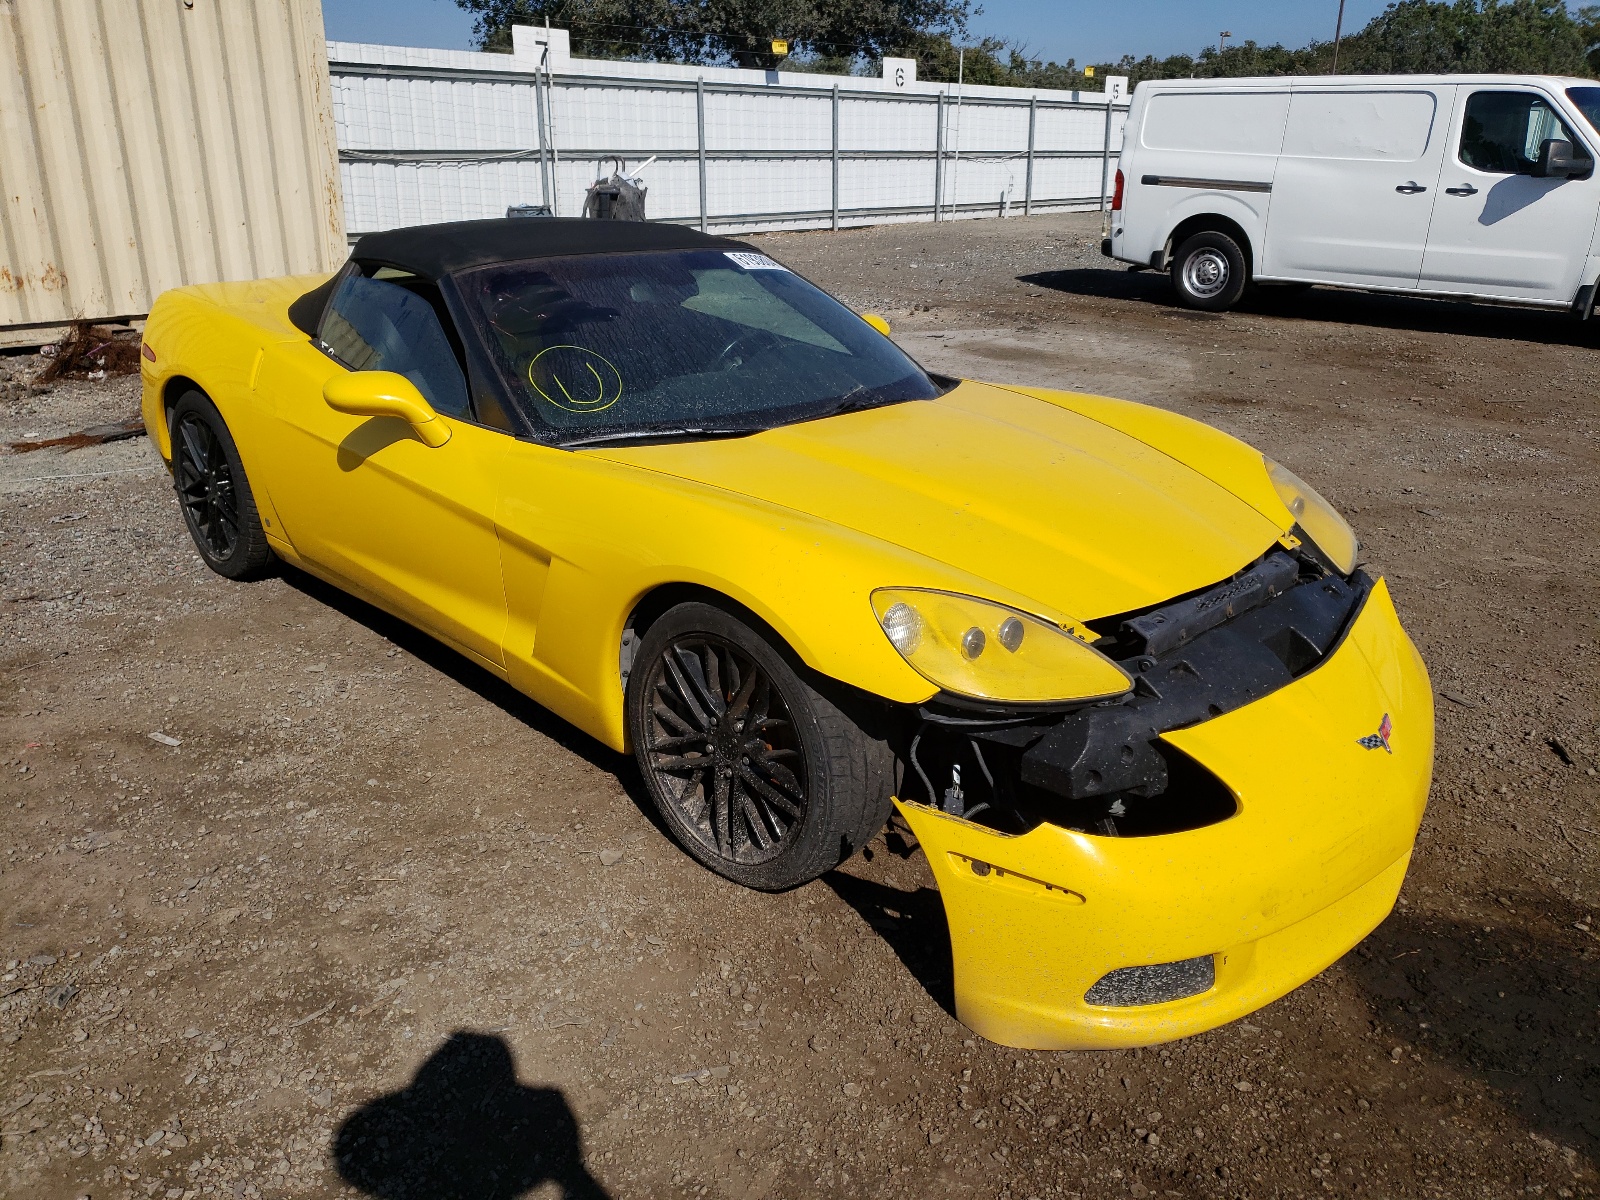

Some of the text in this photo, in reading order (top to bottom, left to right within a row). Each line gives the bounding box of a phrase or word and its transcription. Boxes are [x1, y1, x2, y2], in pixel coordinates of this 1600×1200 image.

[535, 40, 549, 66] 7
[895, 67, 905, 88] 6
[1112, 83, 1120, 100] 5
